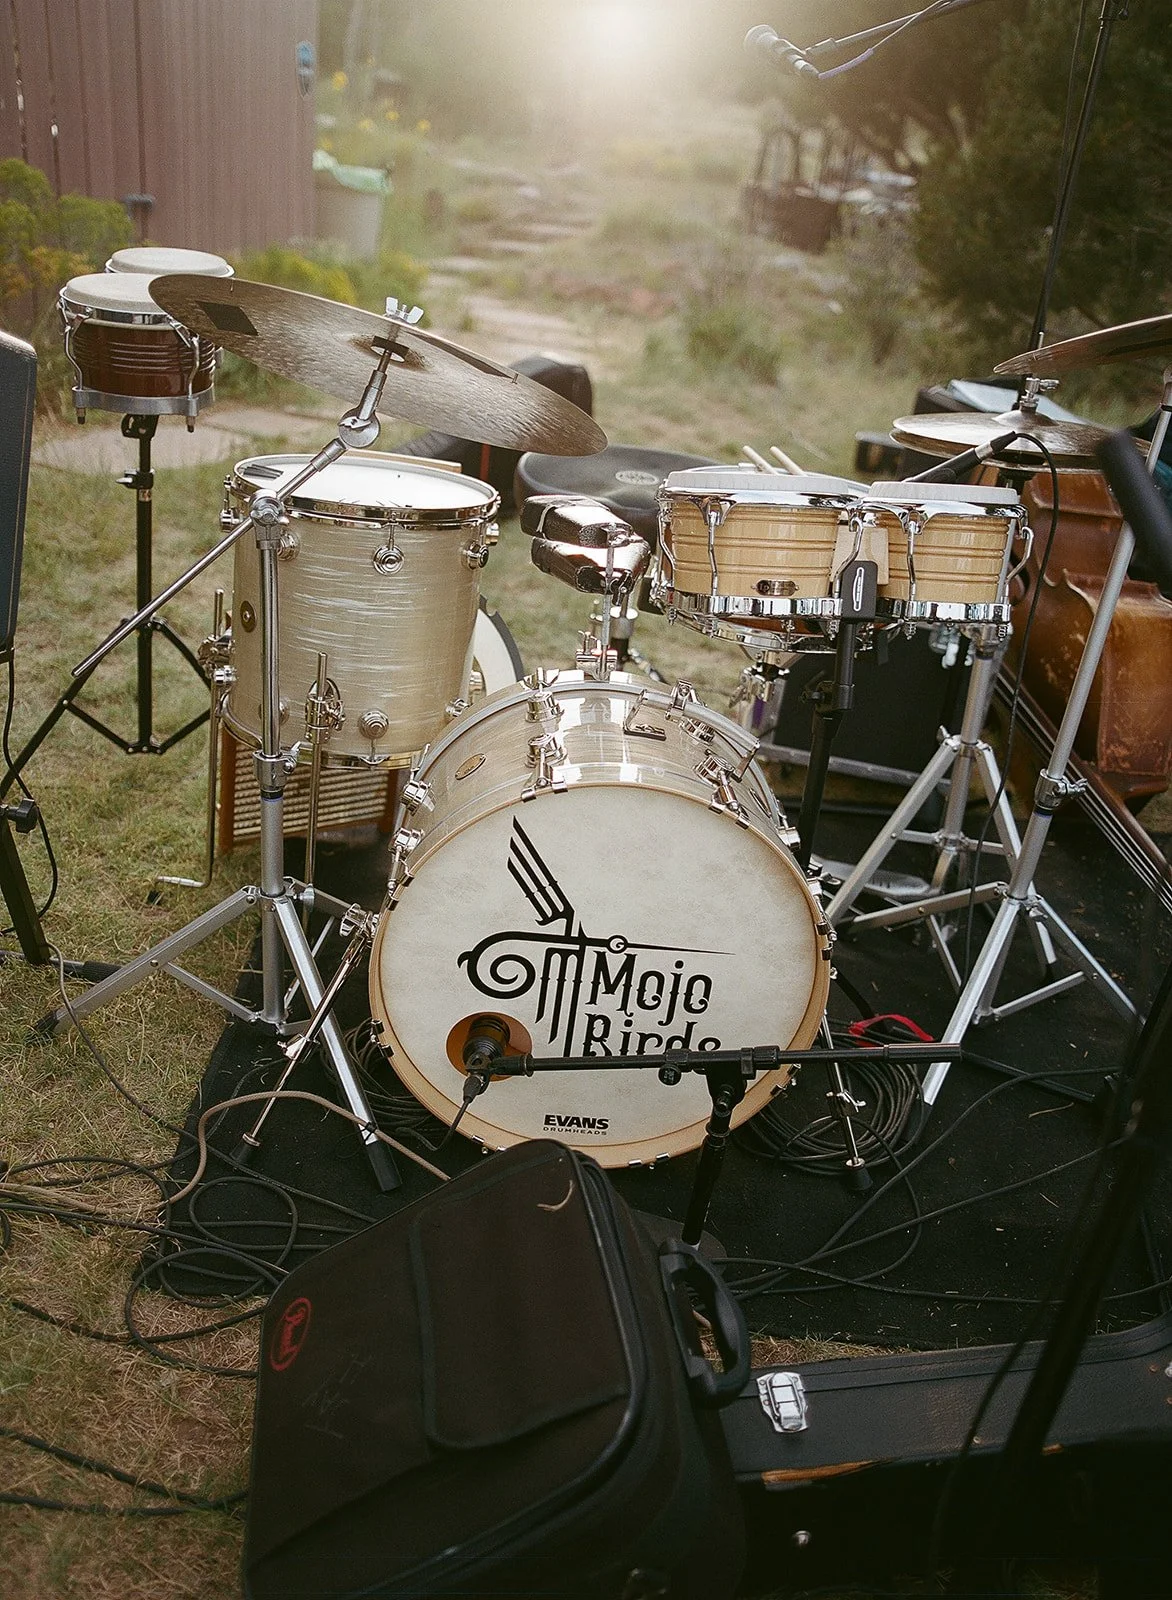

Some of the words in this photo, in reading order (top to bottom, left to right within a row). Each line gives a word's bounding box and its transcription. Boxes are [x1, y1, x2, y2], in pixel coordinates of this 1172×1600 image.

[585, 951, 713, 1026] Mojo
[544, 1114, 609, 1130] EVANS
[543, 1126, 607, 1135] DRUMHEADS
